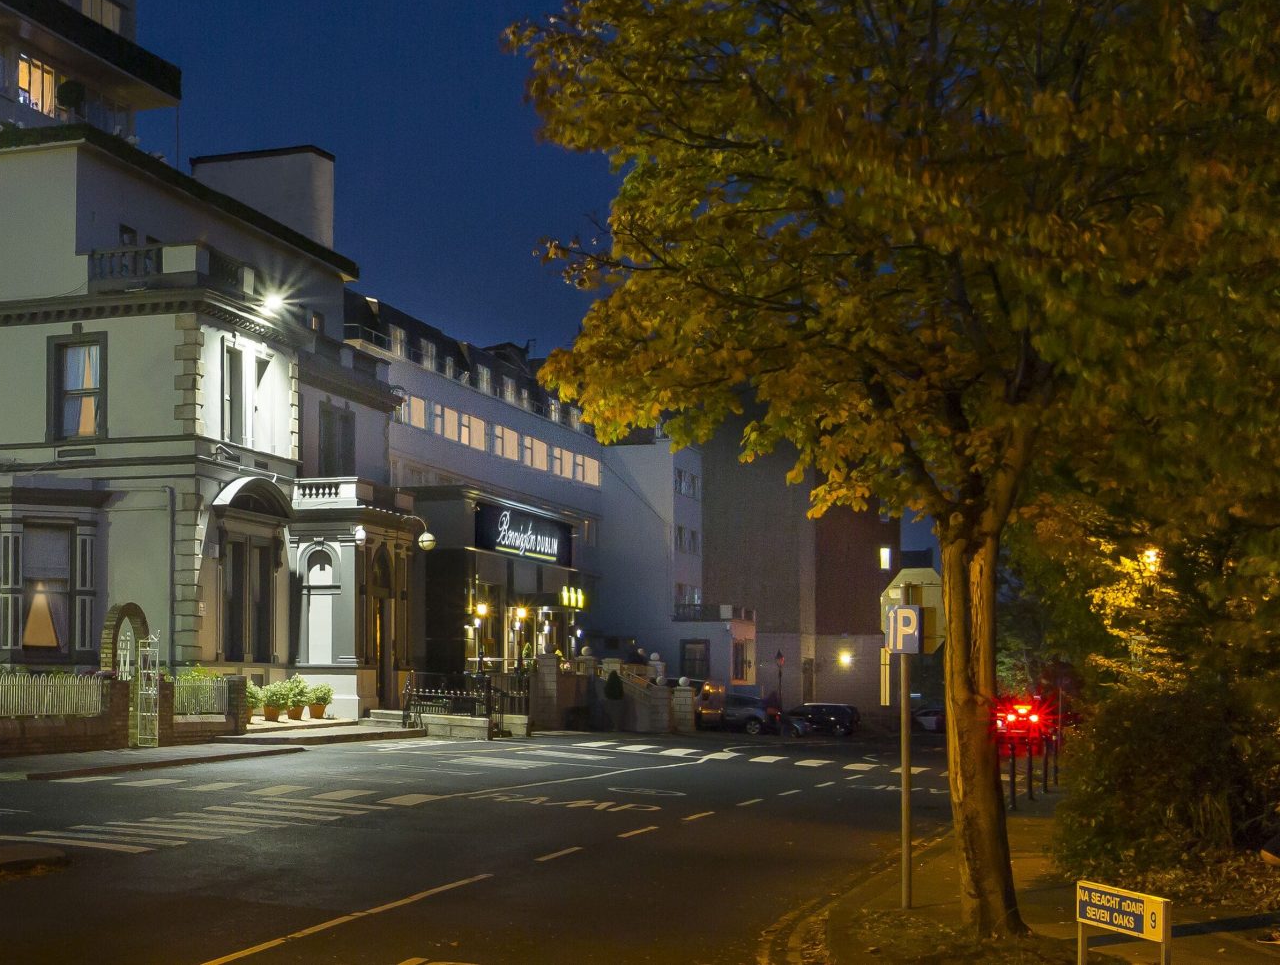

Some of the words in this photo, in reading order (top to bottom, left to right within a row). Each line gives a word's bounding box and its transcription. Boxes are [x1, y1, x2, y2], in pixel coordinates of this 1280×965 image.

[496, 510, 536, 555] Bonnington
[536, 534, 558, 555] DUBLIN
[897, 609, 917, 650] P
[1079, 889, 1089, 901] NA
[1091, 892, 1120, 910] SEACHT
[1121, 901, 1144, 915] nDAIR
[1086, 906, 1110, 923] SEVEN
[1112, 912, 1135, 929] OAKS
[1150, 911, 1157, 930] 9
